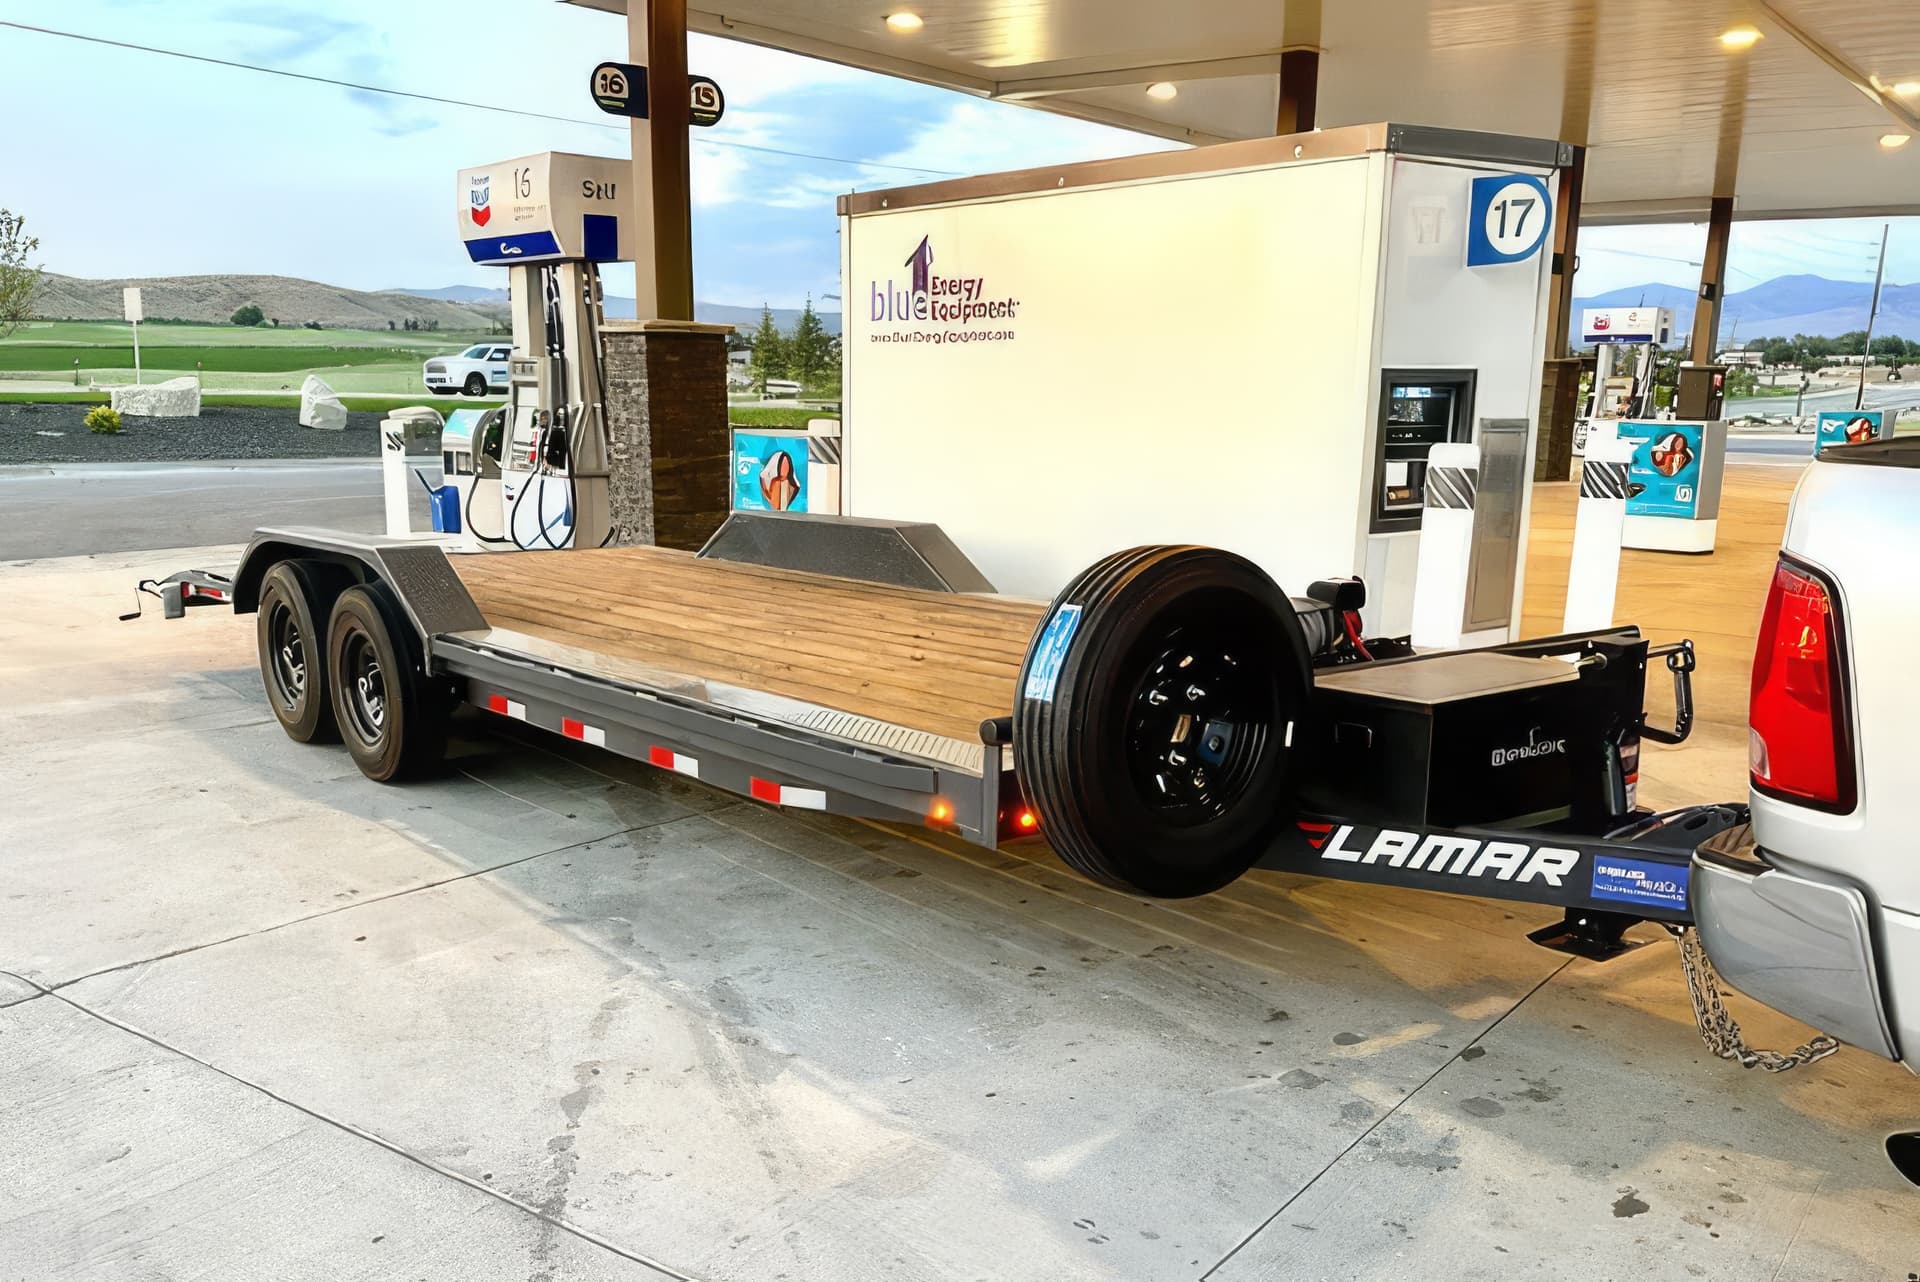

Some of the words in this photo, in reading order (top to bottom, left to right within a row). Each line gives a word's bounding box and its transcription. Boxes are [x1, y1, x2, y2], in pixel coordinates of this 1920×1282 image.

[694, 85, 715, 108] 15
[1494, 198, 1536, 239] 17
[871, 279, 928, 321] blue
[1320, 824, 1581, 887] LAMAR
